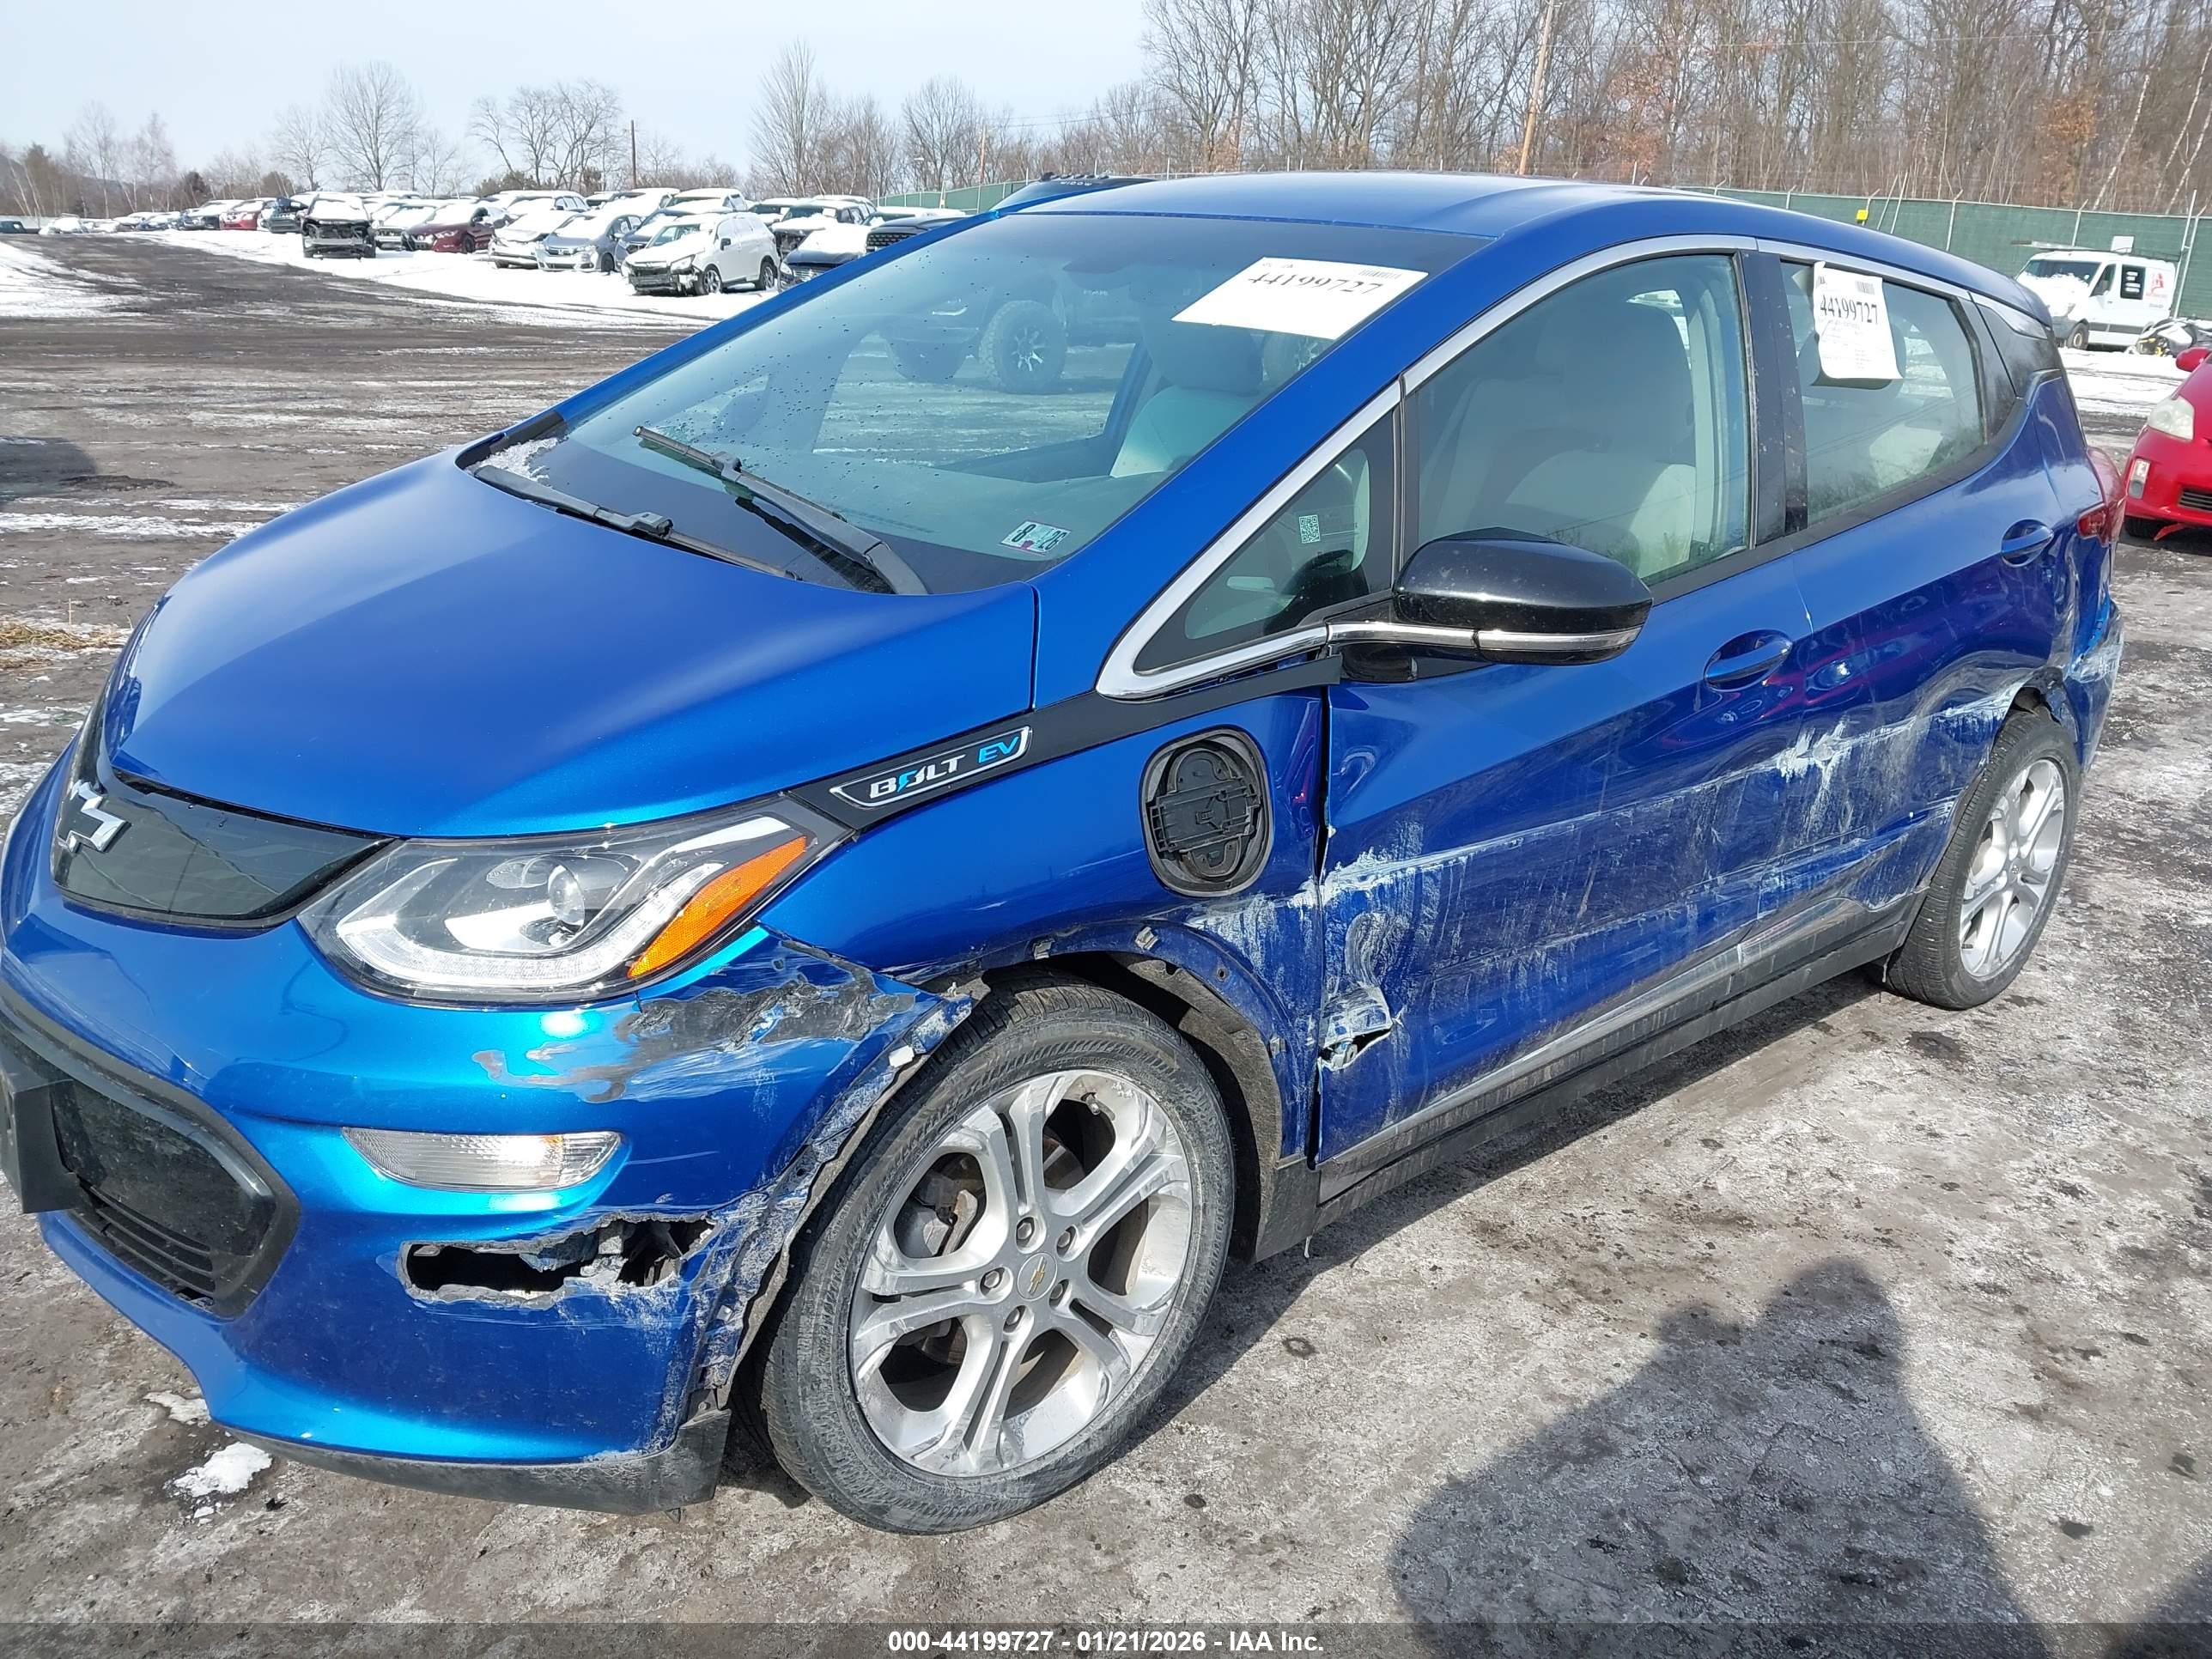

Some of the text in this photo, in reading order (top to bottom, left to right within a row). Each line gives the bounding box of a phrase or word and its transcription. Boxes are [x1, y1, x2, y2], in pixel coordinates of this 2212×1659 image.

[1248, 272, 1384, 295] 44199727
[1820, 295, 1879, 325] 44199727
[1011, 524, 1036, 543] 8
[869, 736, 1019, 799] BOLT EV
